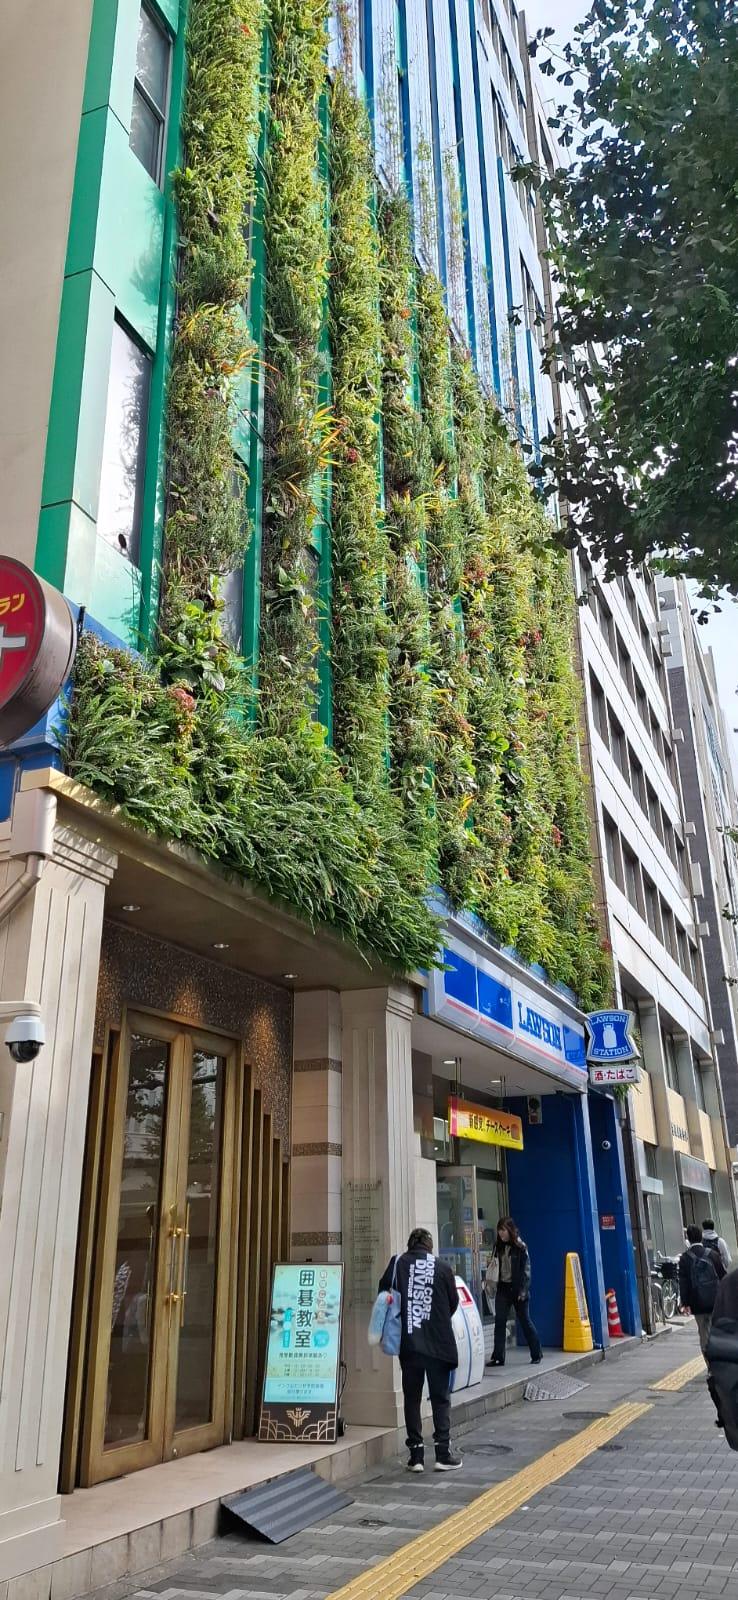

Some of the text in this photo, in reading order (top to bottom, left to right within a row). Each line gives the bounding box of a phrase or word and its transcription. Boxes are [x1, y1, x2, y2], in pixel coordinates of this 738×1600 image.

[518, 1001, 562, 1051] LAWSON
[591, 1014, 627, 1025] LAWSON
[593, 1045, 629, 1056] STATION
[294, 1269, 315, 1348] 囲碁教室
[412, 1259, 426, 1329] DIVISION
[421, 1286, 433, 1320] CORE
